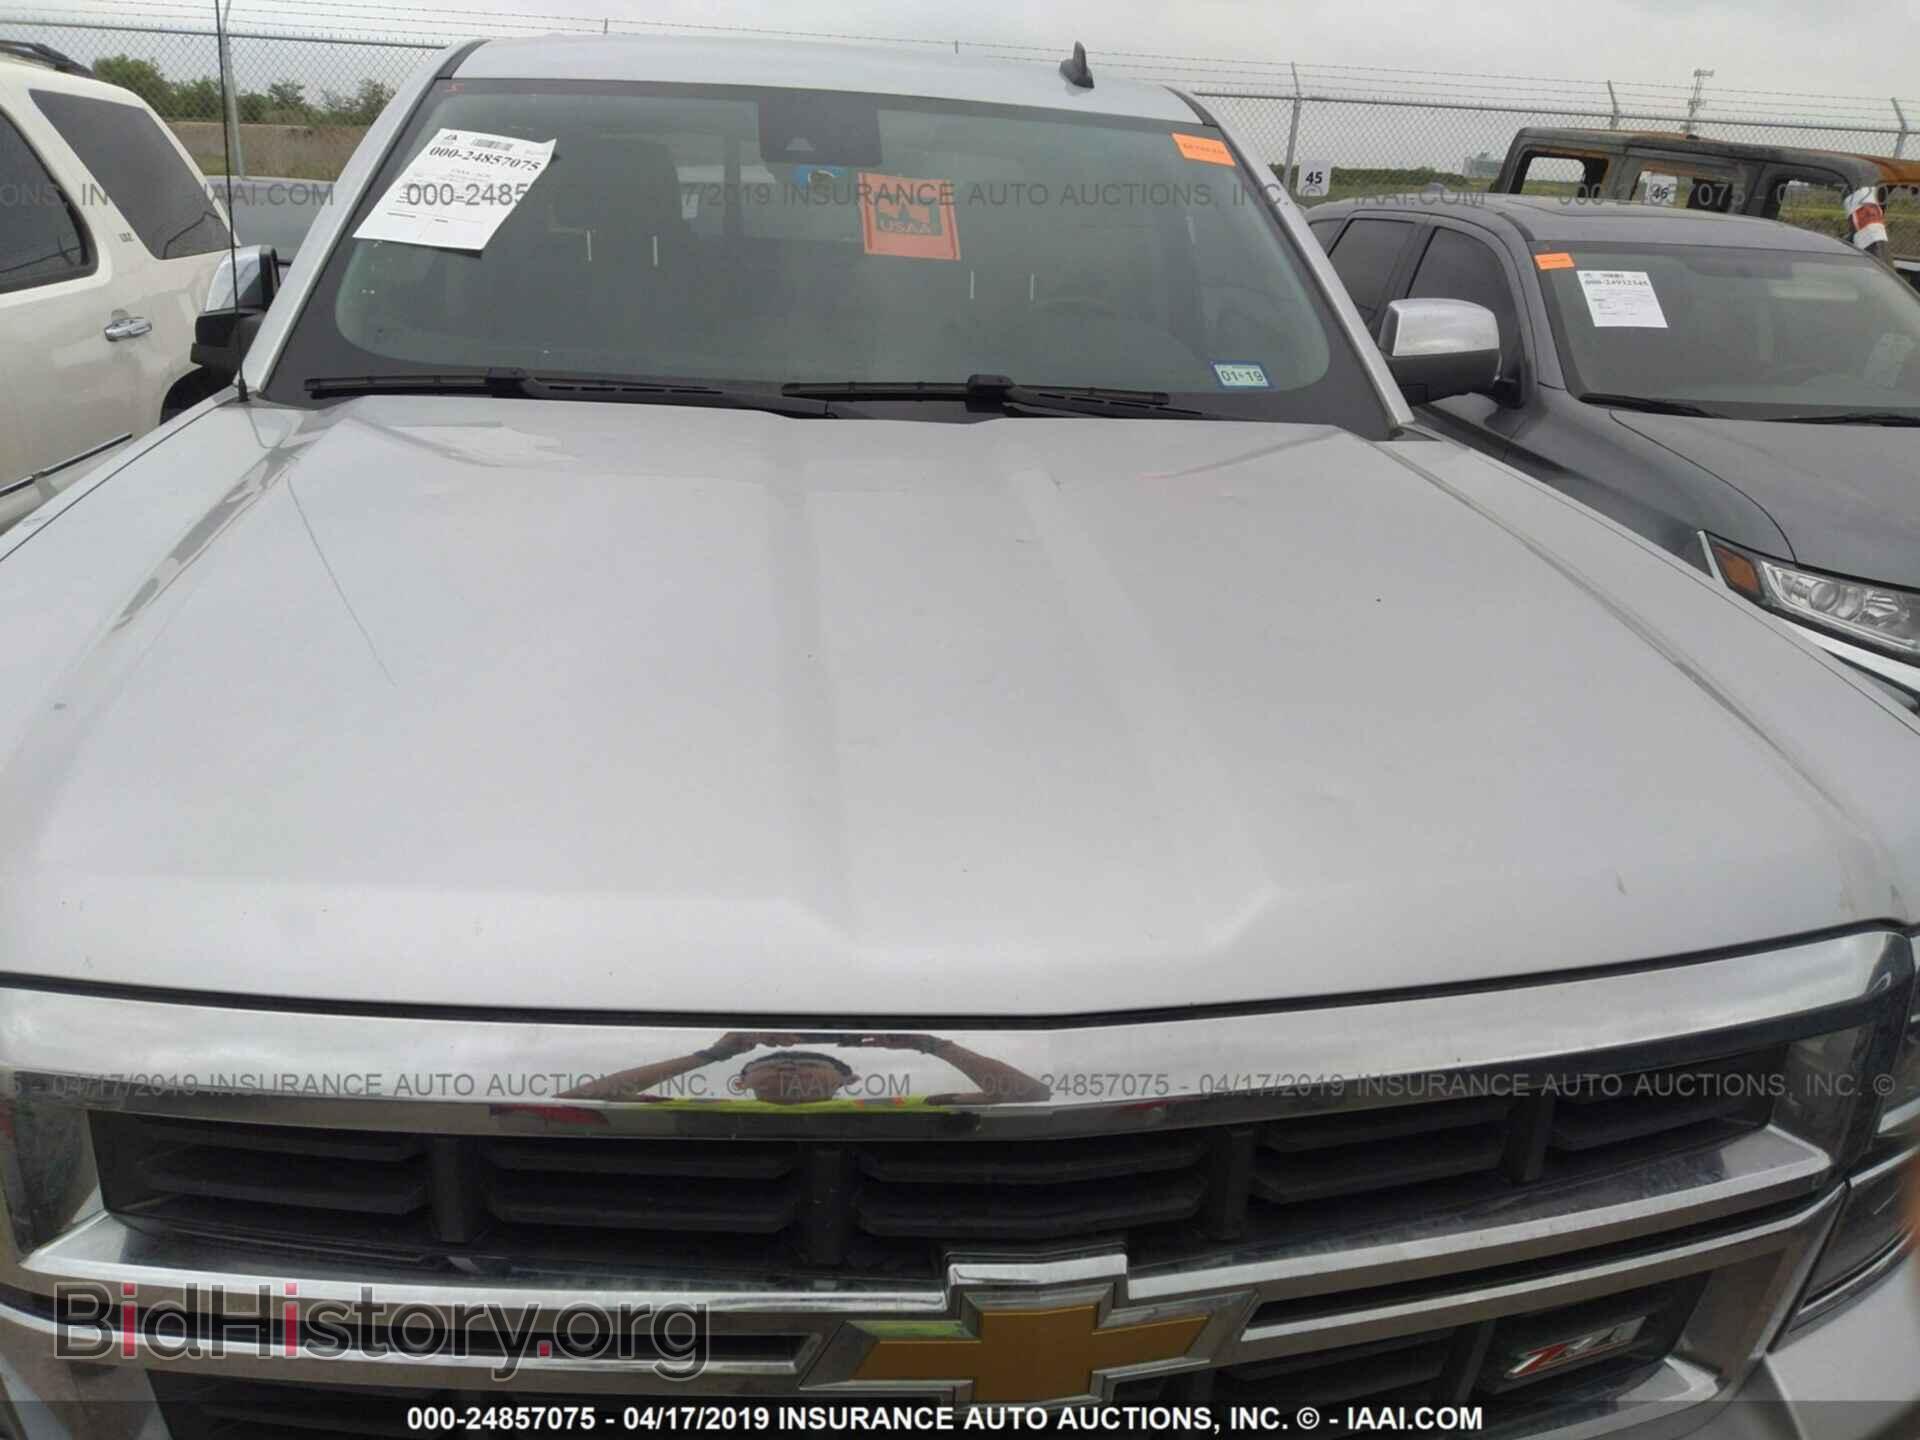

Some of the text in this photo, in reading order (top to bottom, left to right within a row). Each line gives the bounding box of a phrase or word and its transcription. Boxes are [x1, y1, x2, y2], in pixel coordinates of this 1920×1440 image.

[429, 146, 542, 172] 000-24857075
[1305, 171, 1323, 184] 45
[1652, 184, 1669, 199] 46
[879, 218, 932, 234] USAA
